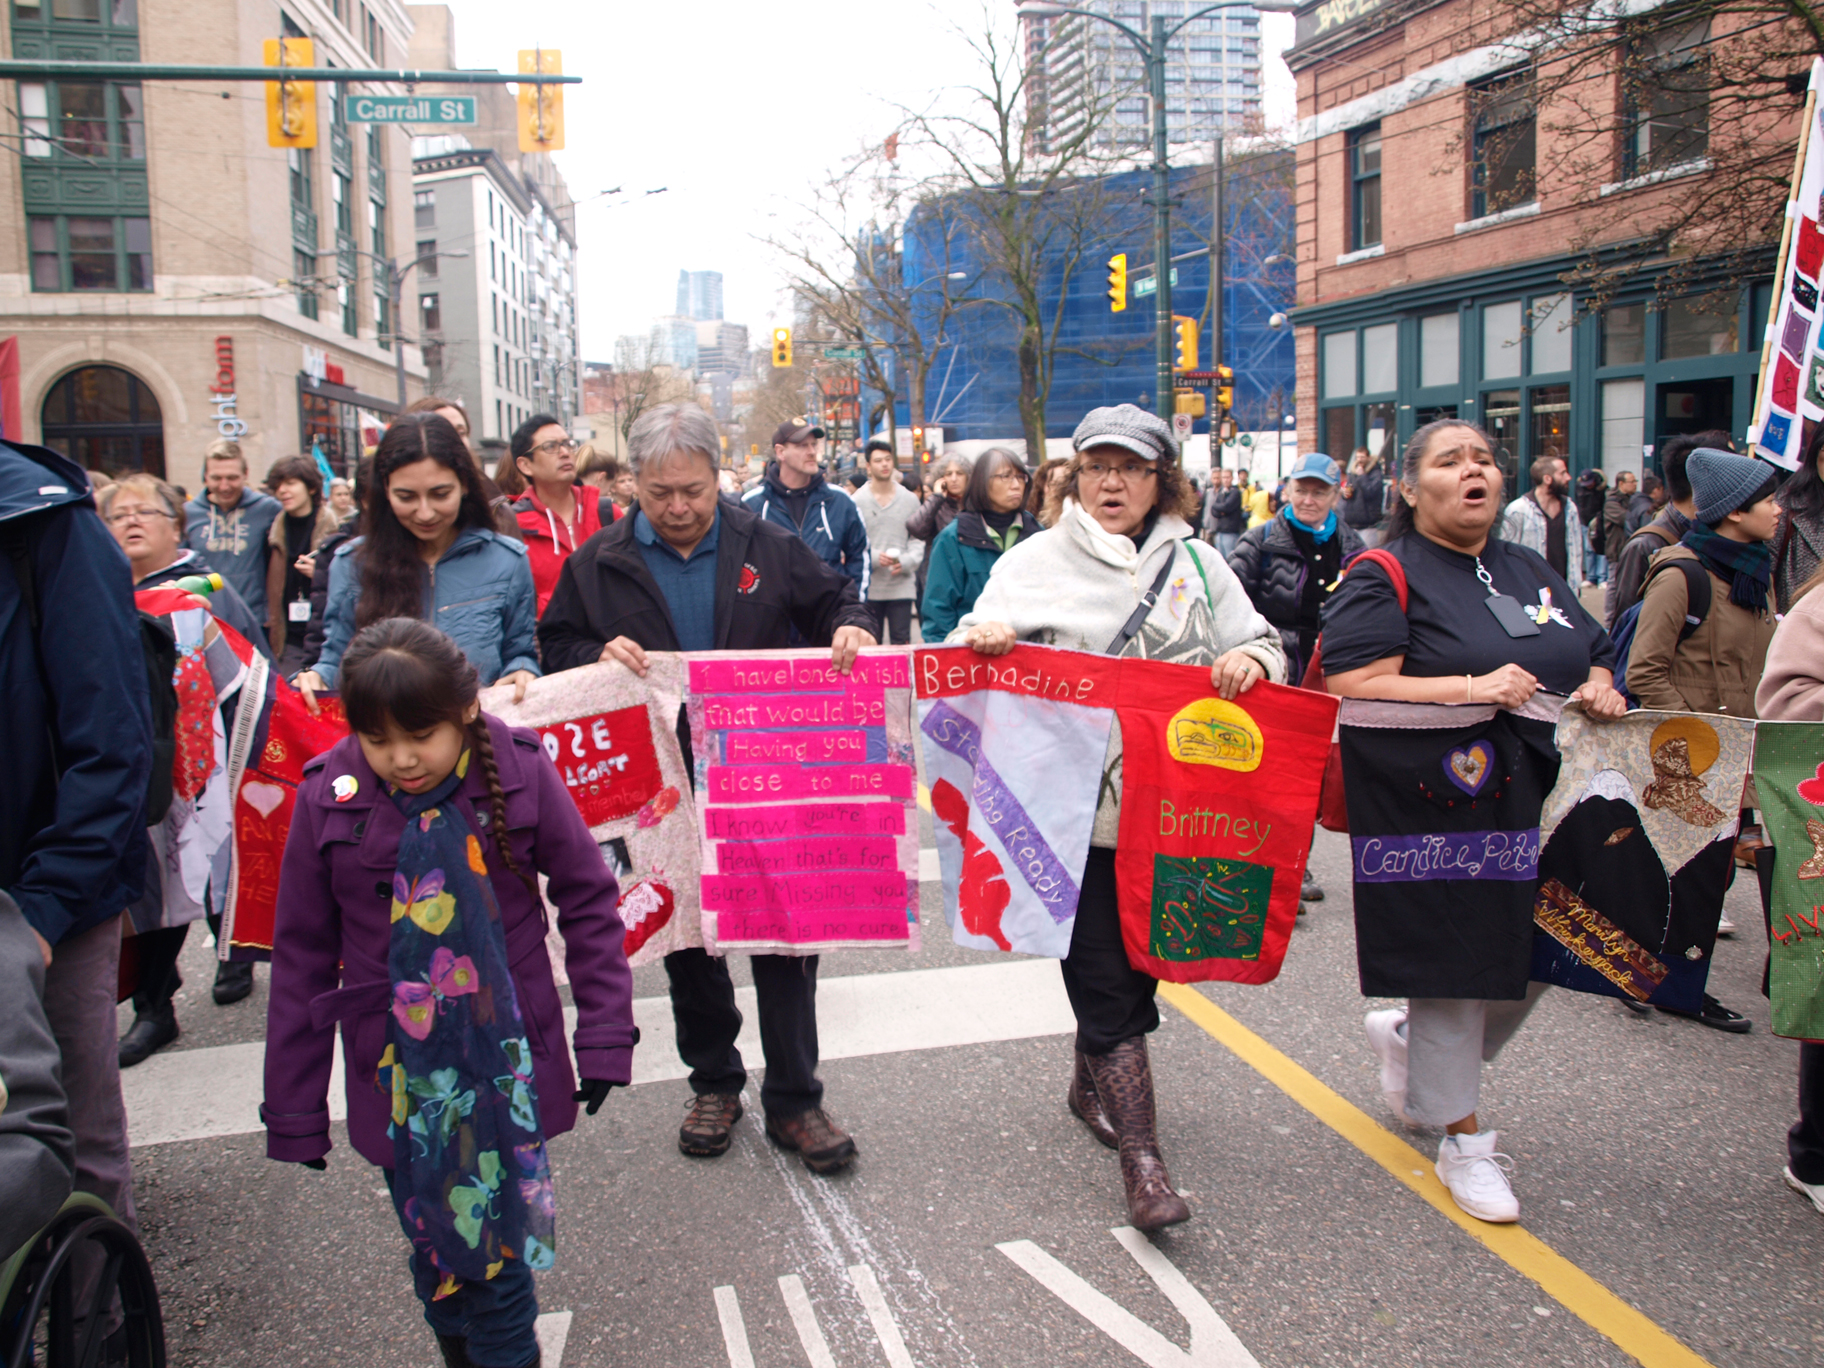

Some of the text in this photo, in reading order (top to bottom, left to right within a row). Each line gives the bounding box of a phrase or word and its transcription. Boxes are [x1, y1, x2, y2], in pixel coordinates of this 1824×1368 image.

[356, 100, 466, 120] Carrall St
[208, 335, 249, 442] ightform
[1178, 377, 1209, 387] Carrall
[1212, 377, 1222, 387] St
[733, 666, 787, 686] have
[799, 668, 838, 684] one
[923, 654, 1094, 700] Bernadine
[706, 693, 884, 725] that would be
[733, 736, 862, 762] Having you
[720, 771, 884, 793] close to me
[711, 807, 896, 836] I know you're in
[1160, 799, 1271, 857] Brittney
[721, 844, 890, 870] Heaven that's for
[1006, 825, 1063, 904] Ready
[1361, 835, 1480, 878] Candice
[711, 880, 904, 906] sure Missing you
[733, 919, 900, 939] there is no cure
[1568, 902, 1633, 963] Marilyn
